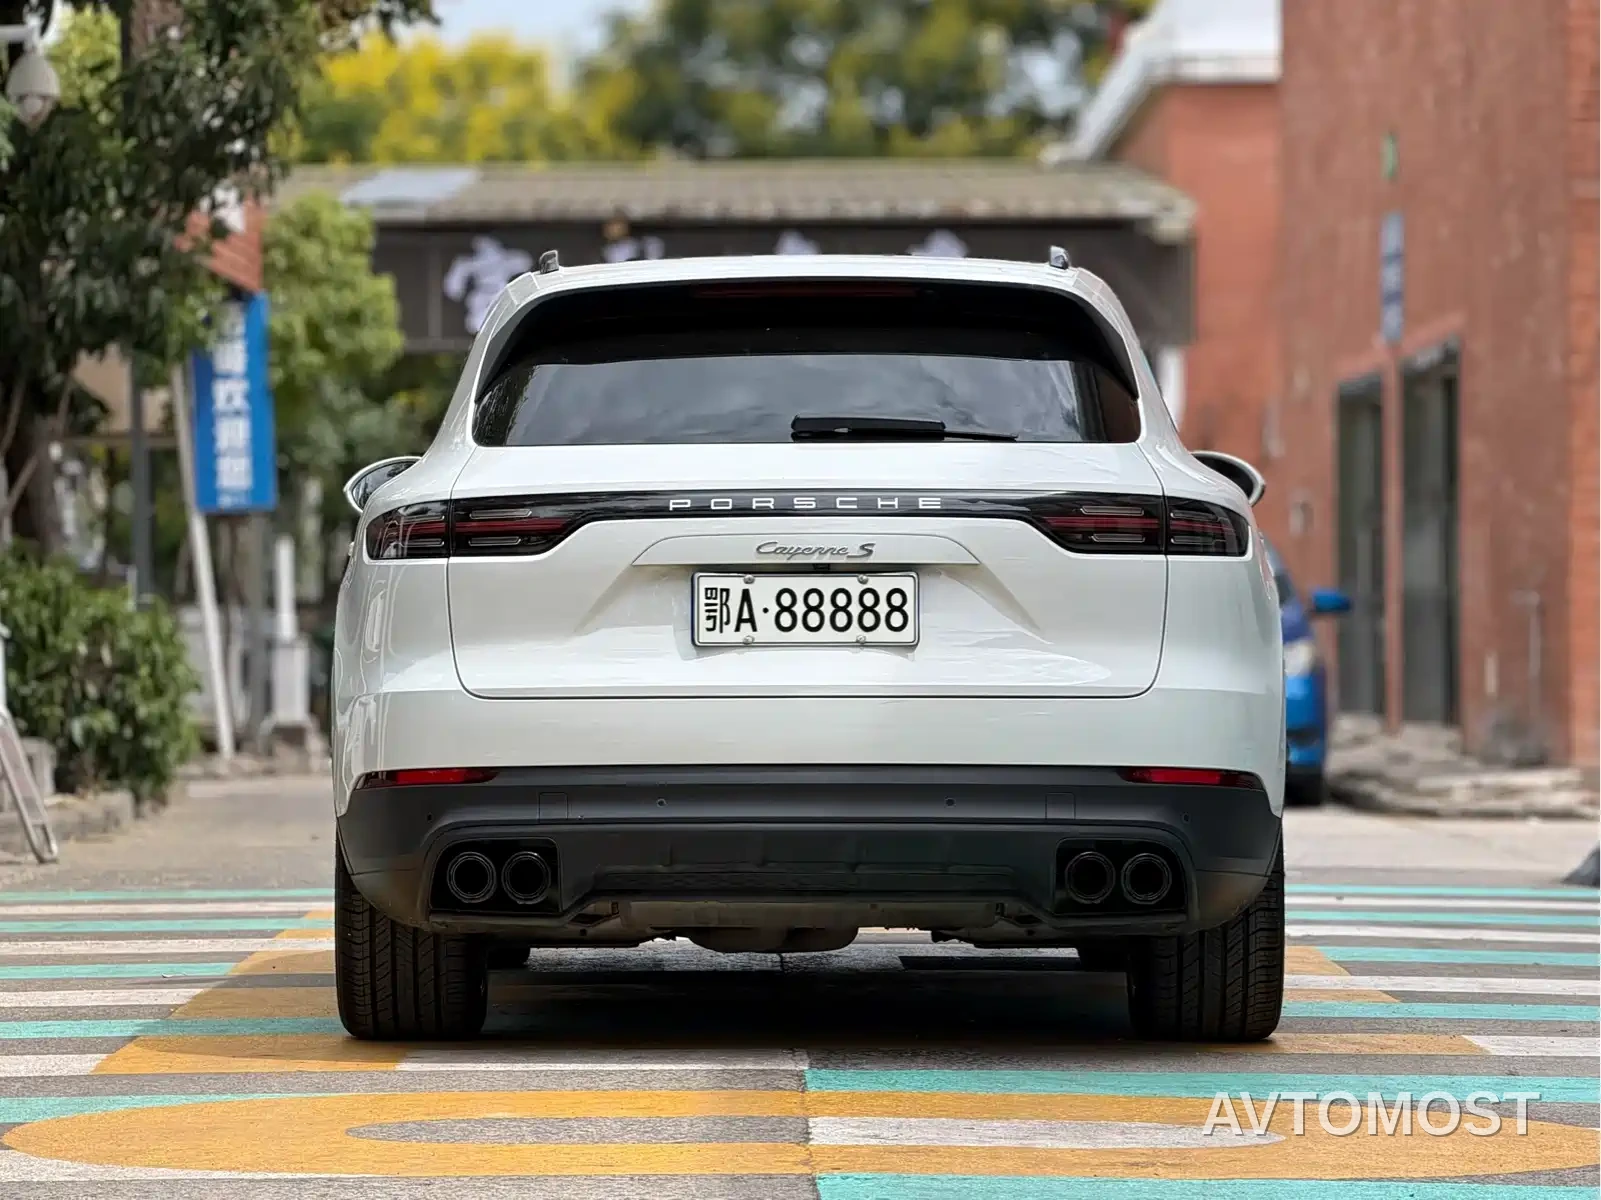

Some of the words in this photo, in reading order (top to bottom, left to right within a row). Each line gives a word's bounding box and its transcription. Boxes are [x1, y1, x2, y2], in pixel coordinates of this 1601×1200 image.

[669, 497, 942, 511] PORSCHE
[756, 541, 849, 561] Cayenne
[846, 542, 876, 559] S
